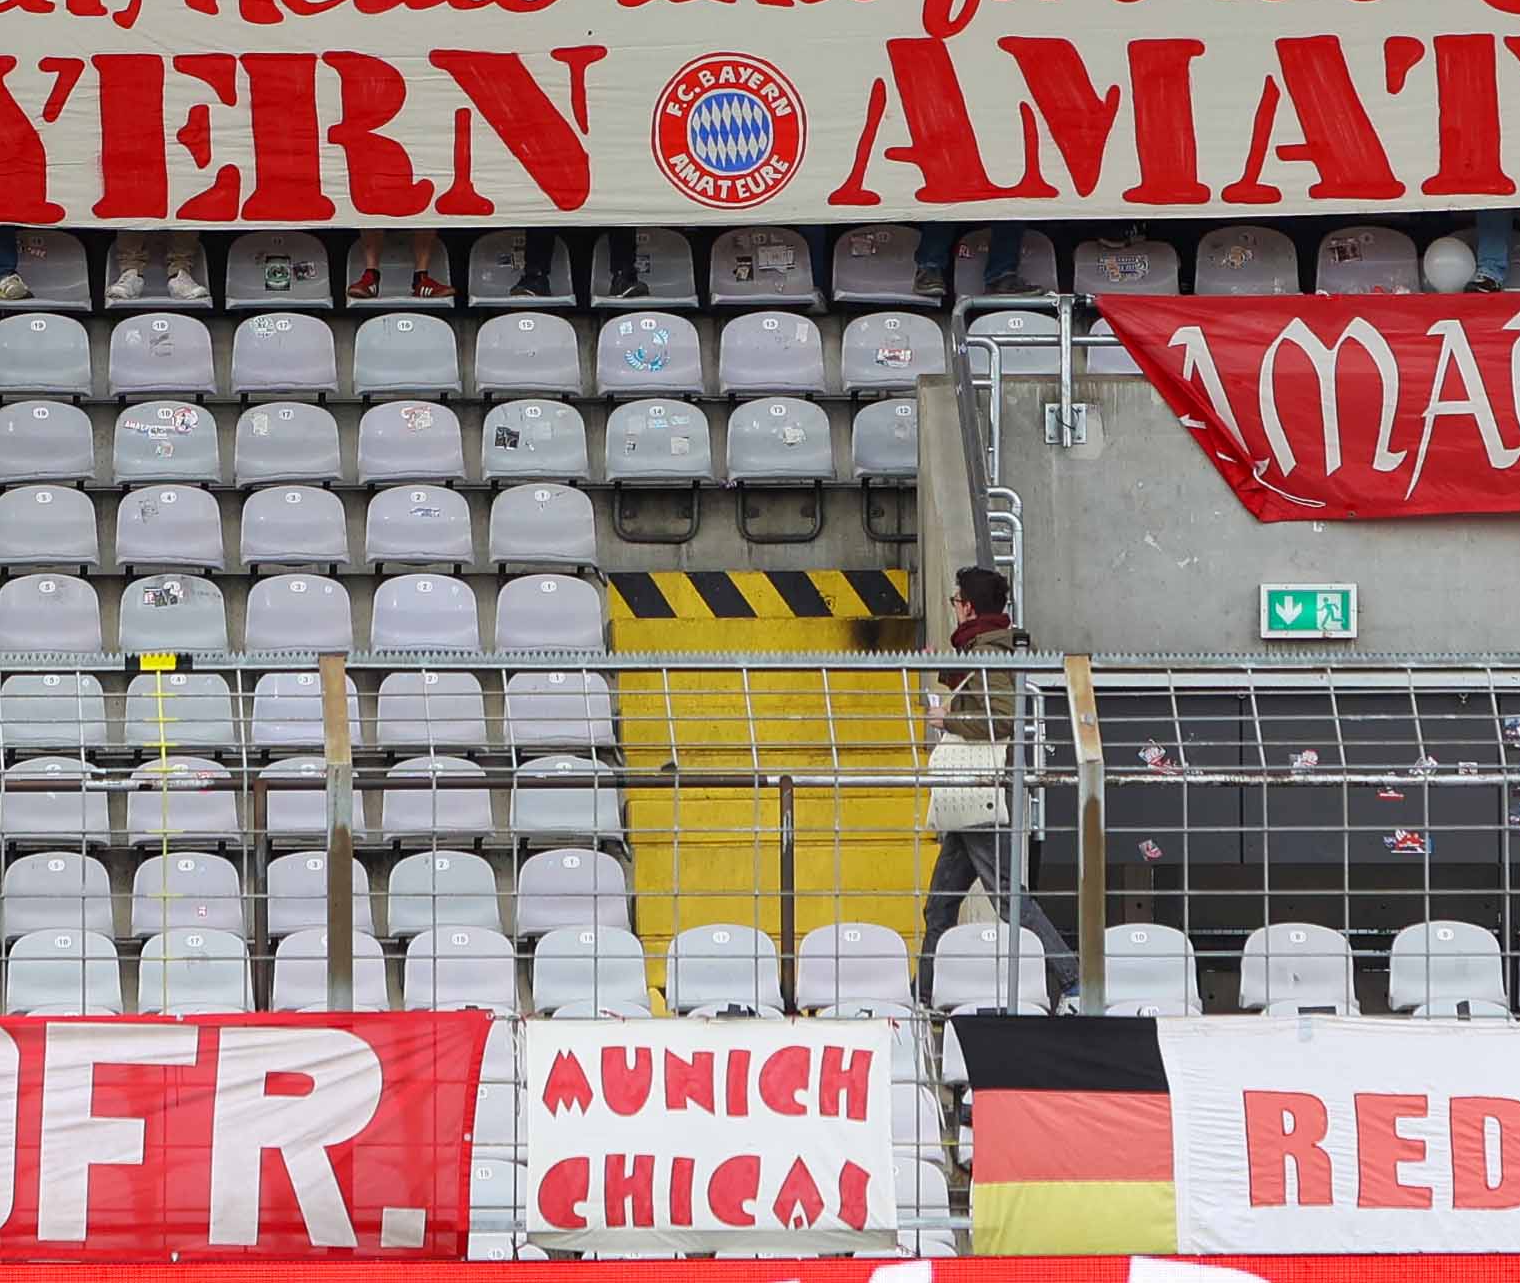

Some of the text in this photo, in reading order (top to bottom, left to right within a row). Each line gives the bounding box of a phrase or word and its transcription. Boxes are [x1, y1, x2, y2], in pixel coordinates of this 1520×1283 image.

[669, 153, 790, 199] AMATEURE
[543, 1046, 872, 1121] MUNICH
[539, 1154, 870, 1230] CHICAS
